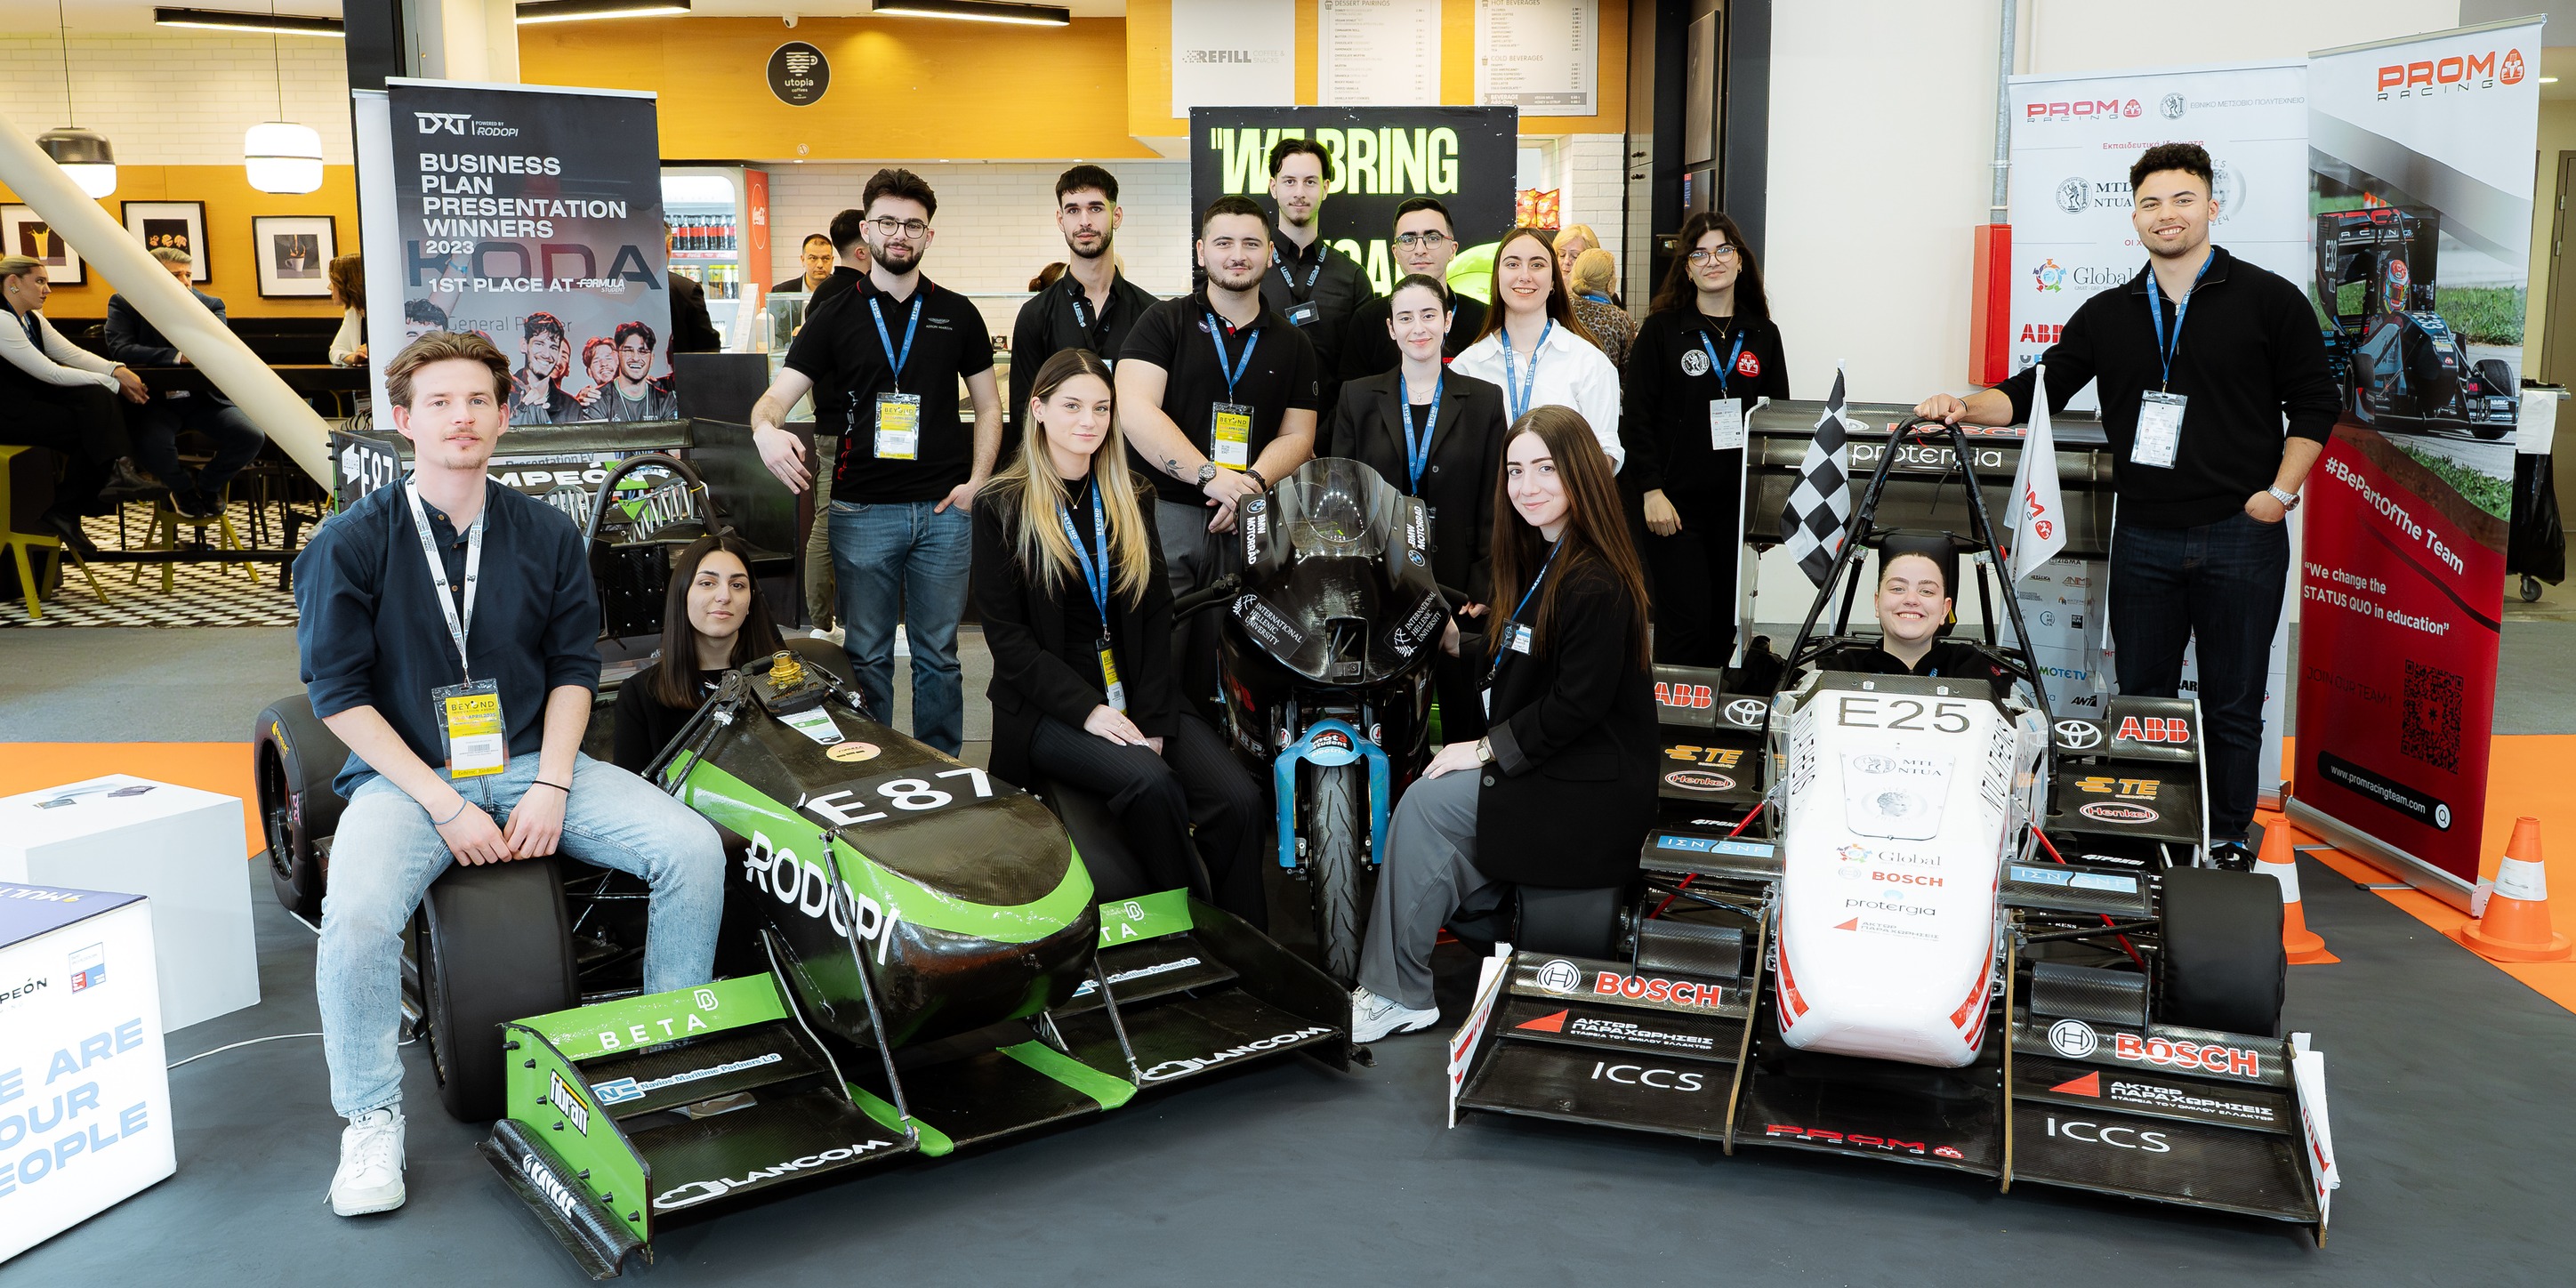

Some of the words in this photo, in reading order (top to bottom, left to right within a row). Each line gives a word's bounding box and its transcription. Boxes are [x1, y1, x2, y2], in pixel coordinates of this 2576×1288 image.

[1195, 50, 1252, 63] REFILL
[785, 78, 814, 88] utopia
[2379, 52, 2496, 93] PROM
[2377, 80, 2493, 101] RACING
[2027, 100, 2119, 117] PROM
[2190, 101, 2216, 109] ΕΘΝΙΚΟ
[2218, 100, 2252, 109] ΜΕΤΣΟΒΙΟ
[477, 126, 519, 137] RODOPI
[2027, 114, 2119, 123] RACING
[420, 153, 561, 176] BUSINESS
[422, 175, 493, 195] PLAN
[423, 197, 626, 219] PRESENTATION
[425, 219, 554, 239] WINNERS
[425, 240, 475, 254] 2023
[429, 278, 468, 293] 1ST
[473, 278, 543, 293] PLACE
[548, 278, 575, 293] AT
[2073, 267, 2132, 286] Global
[1258, 514, 1267, 534] BMW
[1407, 523, 1416, 545] BMW
[1416, 505, 1427, 551] MOTORRAD
[1246, 517, 1256, 565] MOTORRAD
[2426, 528, 2464, 576] Team
[2332, 568, 2367, 590] change
[2370, 577, 2387, 595] the
[1405, 591, 1437, 631] INTERNATIONAL
[2304, 585, 2347, 608] STATUS
[2349, 596, 2372, 616] QUO
[2374, 603, 2384, 620] in
[1244, 616, 1280, 646] UNIVERSITY
[1250, 608, 1279, 634] HELLENIC
[1255, 601, 1302, 643] INTERNATIONAL
[1412, 609, 1434, 637] HELLENIC
[1417, 610, 1442, 642] UNIVERSITY
[1654, 681, 1712, 710] ABB
[2306, 666, 2333, 688] JOIN
[2335, 675, 2355, 696] OUR
[2357, 681, 2387, 705] TEAM
[1838, 696, 1970, 733] E25
[1313, 735, 1348, 745] moto
[2117, 715, 2191, 744] ABB
[1313, 740, 1348, 750] student
[1705, 747, 1743, 765] TE
[1672, 775, 1729, 787] Henkel
[1898, 767, 1942, 776] NTUA
[801, 768, 993, 826] E87
[2118, 779, 2160, 796] TE
[2330, 763, 2427, 815] www.promracingteam.com
[2089, 808, 2151, 819] Henkel
[1721, 843, 1766, 854] SNF
[1879, 850, 1941, 866] Global
[1872, 871, 1943, 888] BOSCH
[744, 830, 901, 967] RODOPI
[1846, 898, 1936, 916] protergia
[1594, 971, 1722, 1007] BOSCH
[598, 1012, 708, 1050] BETA
[1572, 1023, 1714, 1045] ΠΑΡΑΧΩΡΗΣΕΙΣ
[1574, 1018, 1638, 1028] ΑΚΤΩΡ
[44, 1017, 144, 1085] ARE
[1192, 1026, 1332, 1066] LANCOM
[2114, 1032, 2261, 1078] BOSCH
[640, 1076, 673, 1091] Navios
[674, 1068, 717, 1084] Maritime
[718, 1059, 762, 1075] Partners
[1590, 1060, 1703, 1092] ICCS
[2110, 1087, 2274, 1116] ΠΑΡΑΧΩΡΗΣΕΙΣ
[2111, 1082, 2183, 1096] ΑΚΤΩΡ
[0, 1080, 101, 1152] OUR
[1767, 1123, 1925, 1153] PROM
[2046, 1117, 2171, 1154] ICCS
[0, 1101, 149, 1199] EOPLE
[719, 1139, 893, 1188] LANCOM
